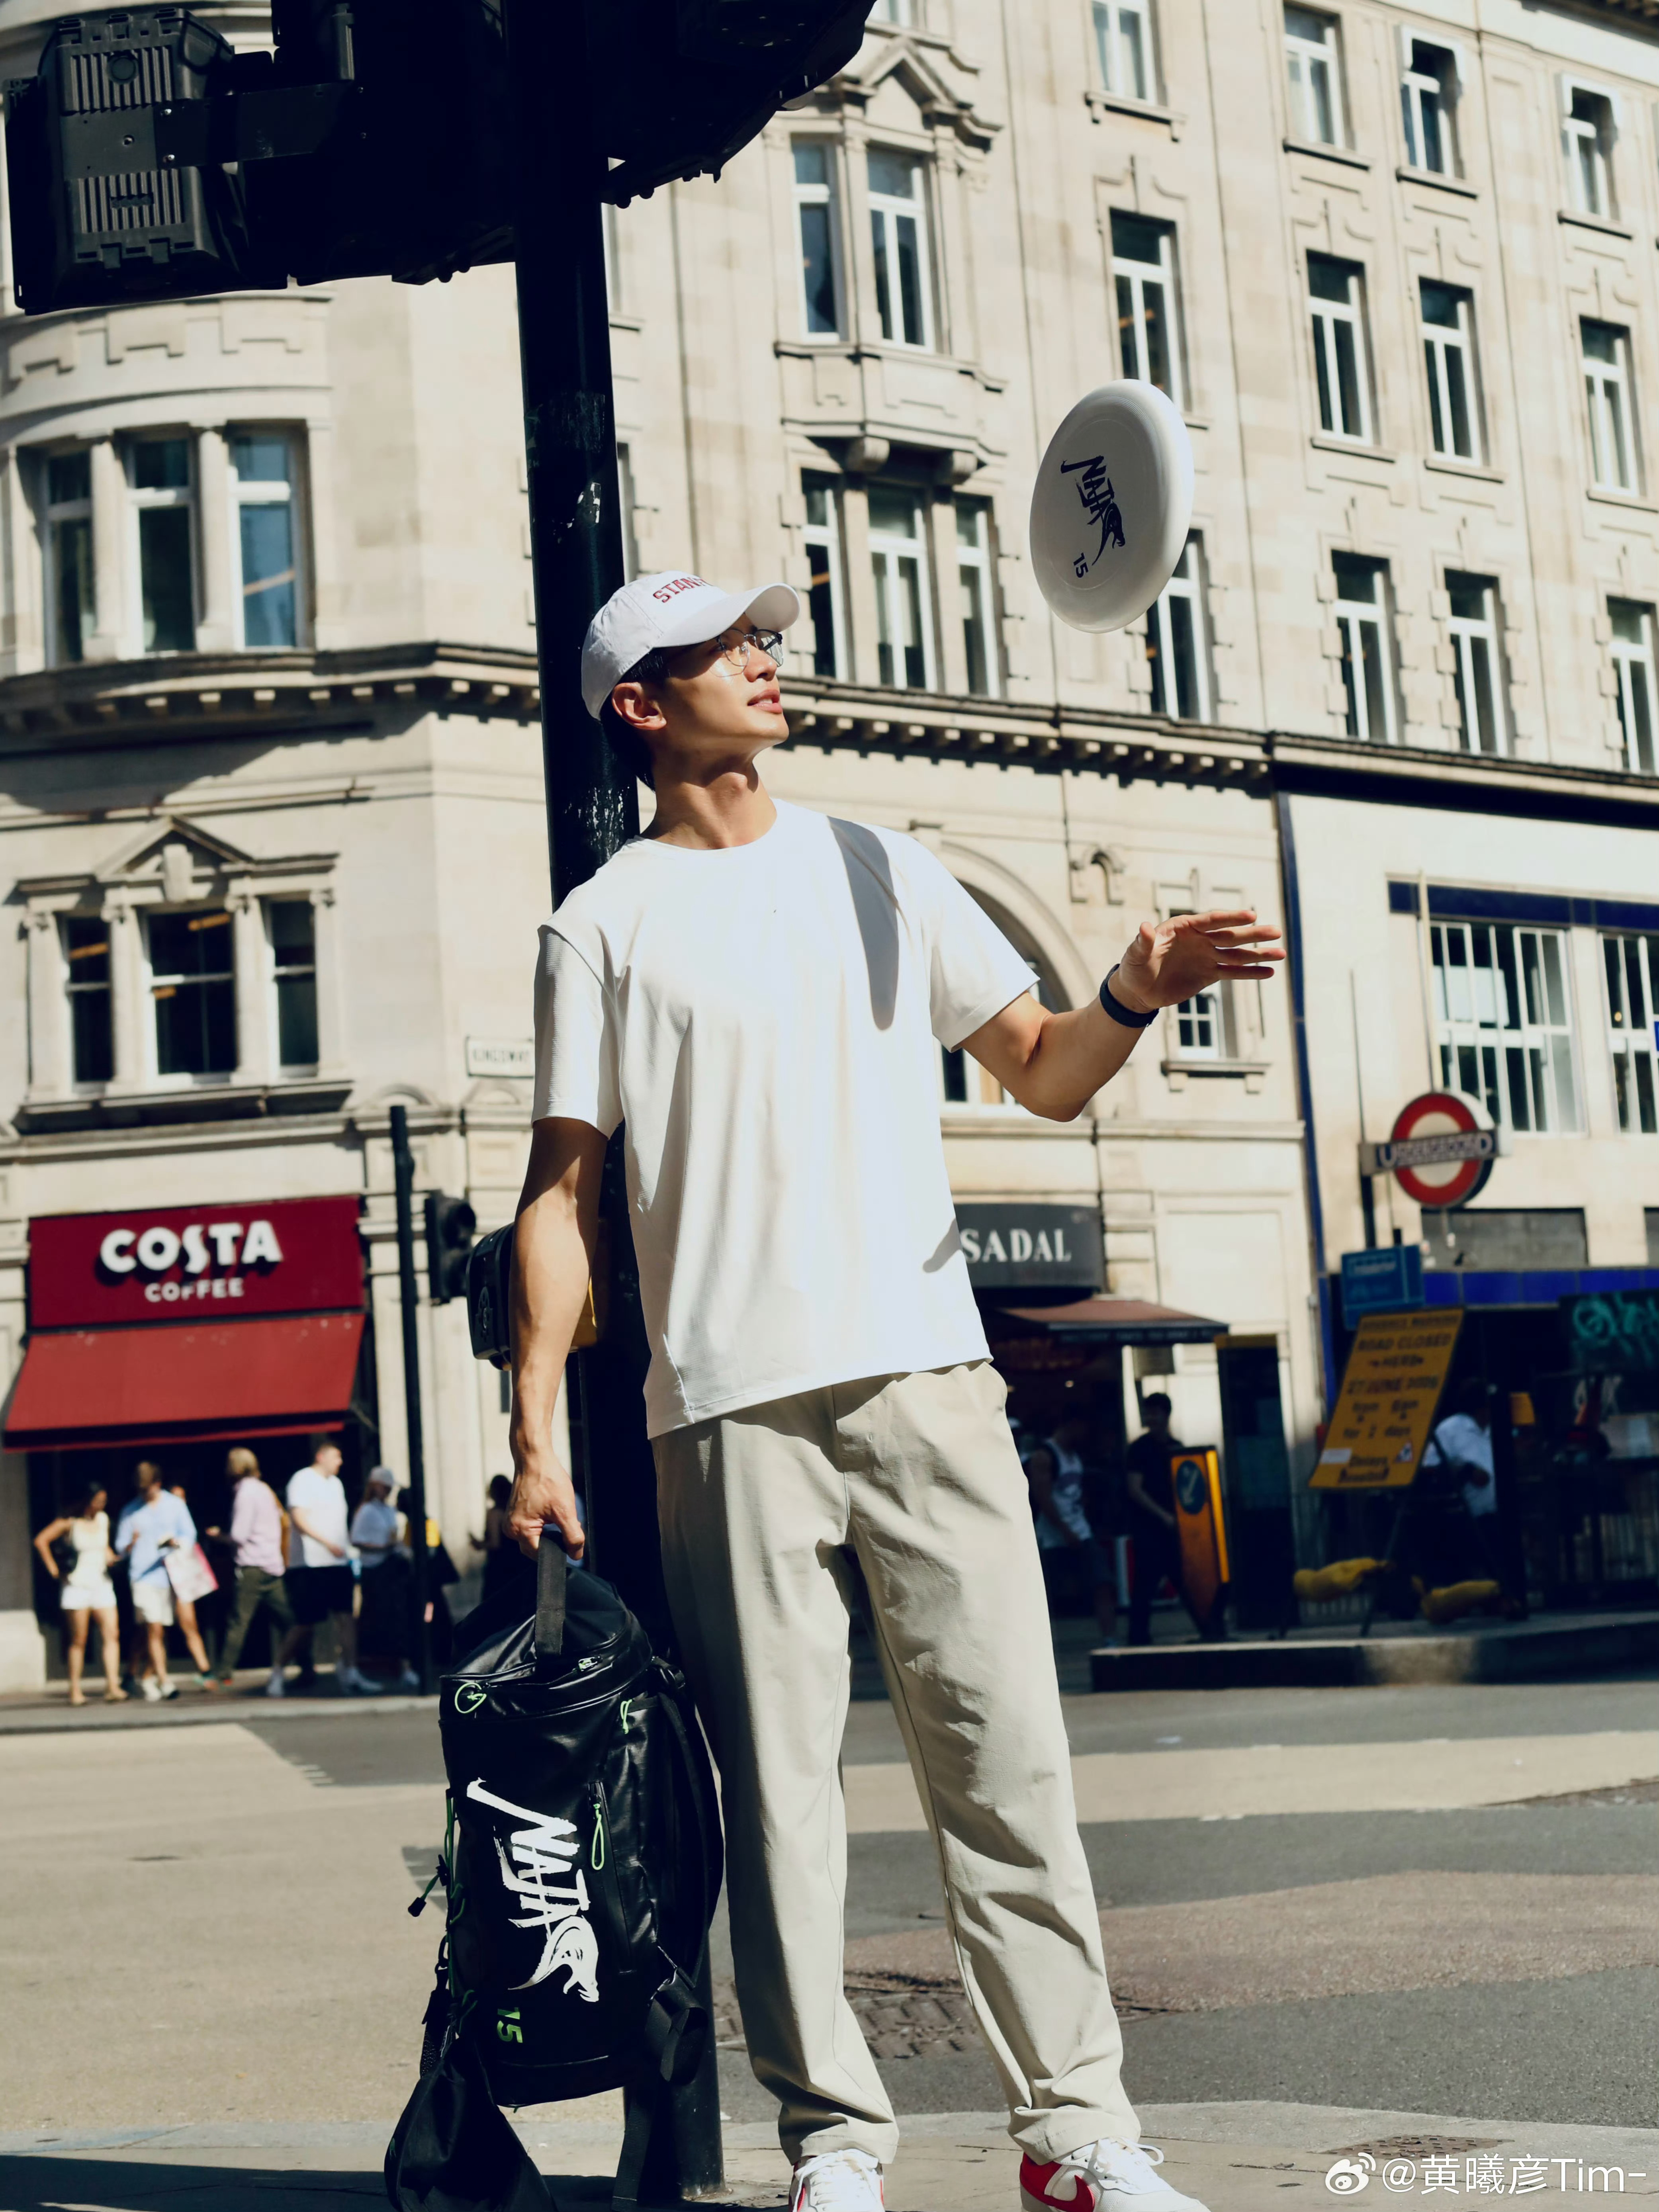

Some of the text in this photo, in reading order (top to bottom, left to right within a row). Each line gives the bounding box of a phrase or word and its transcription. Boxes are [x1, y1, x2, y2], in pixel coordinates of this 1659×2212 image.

[1073, 552, 1089, 578] 15
[100, 1220, 283, 1273] COSTA
[145, 1278, 244, 1303] COFFEE
[1397, 1333, 1452, 1349] CLOSED
[497, 2007, 523, 2043] 15
